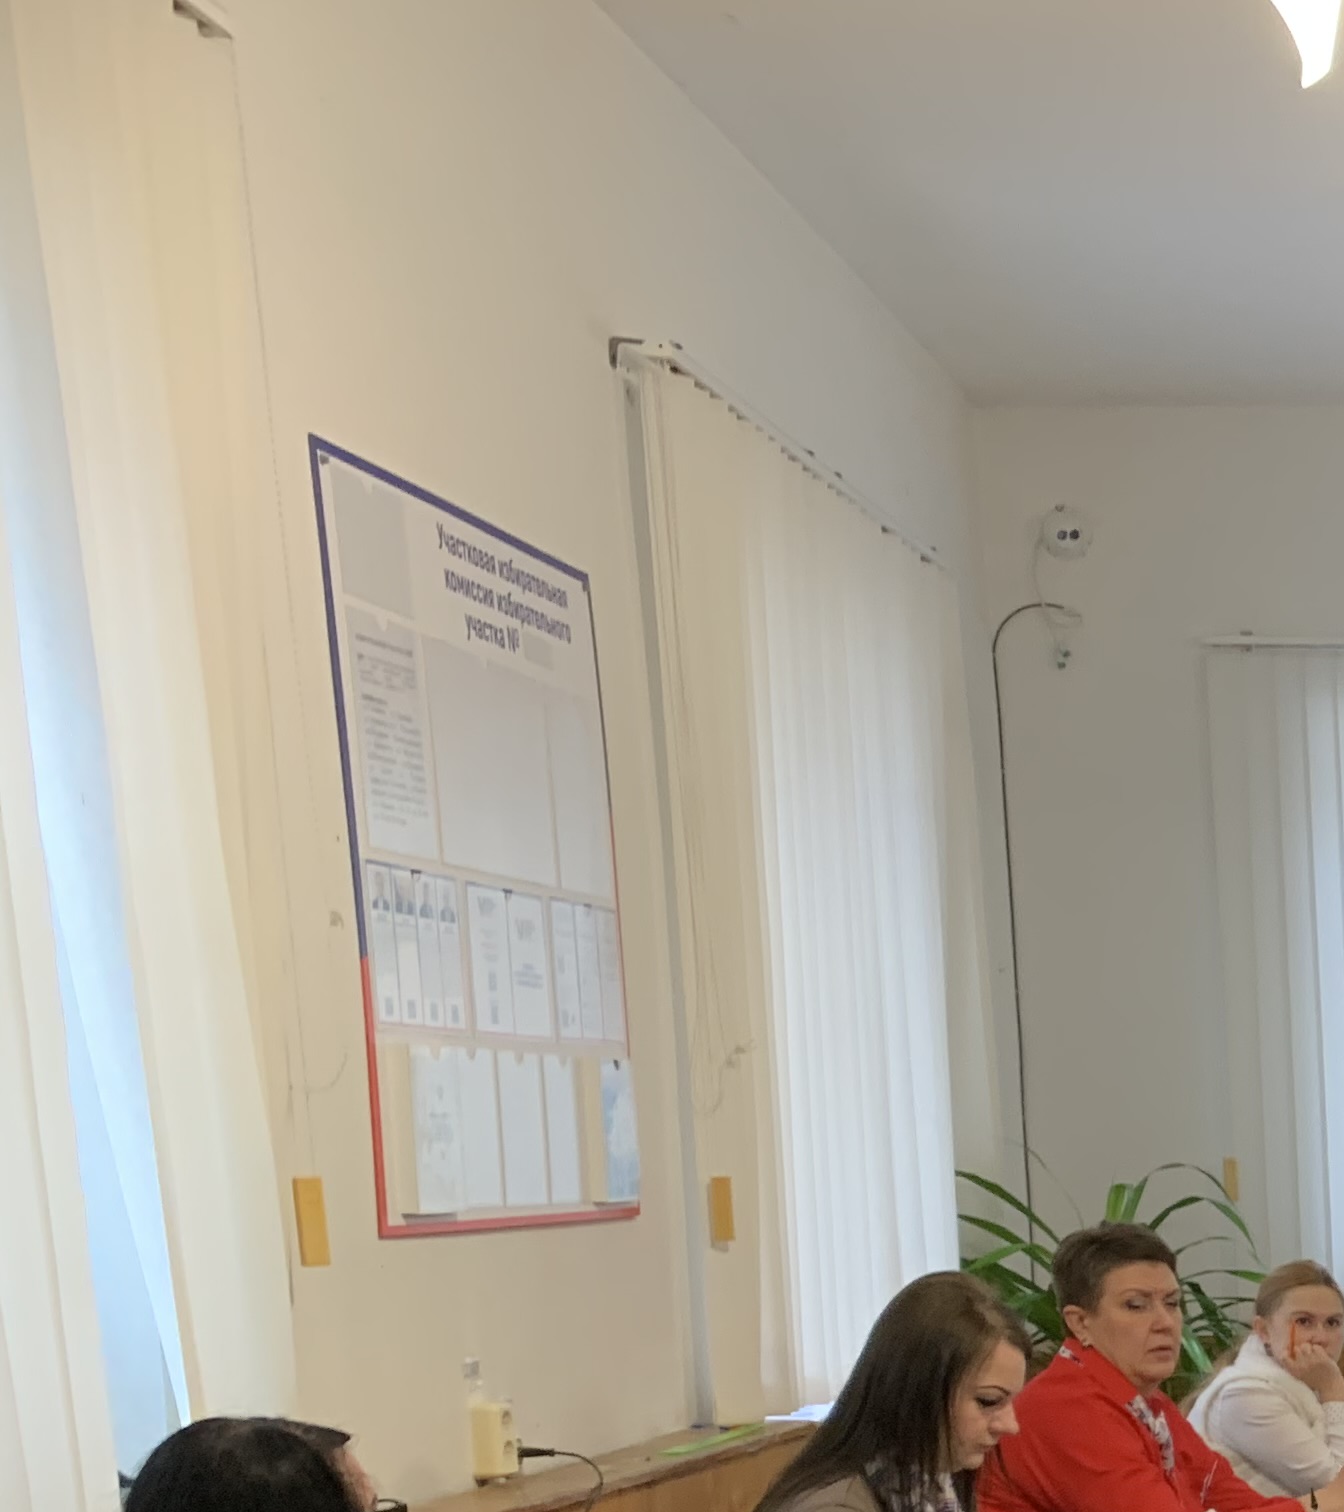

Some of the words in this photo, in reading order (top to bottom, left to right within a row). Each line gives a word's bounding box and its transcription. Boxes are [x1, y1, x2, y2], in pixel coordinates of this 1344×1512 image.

[436, 521, 497, 575] Участковая
[443, 567, 495, 610] комиссия
[464, 612, 506, 650] участка
